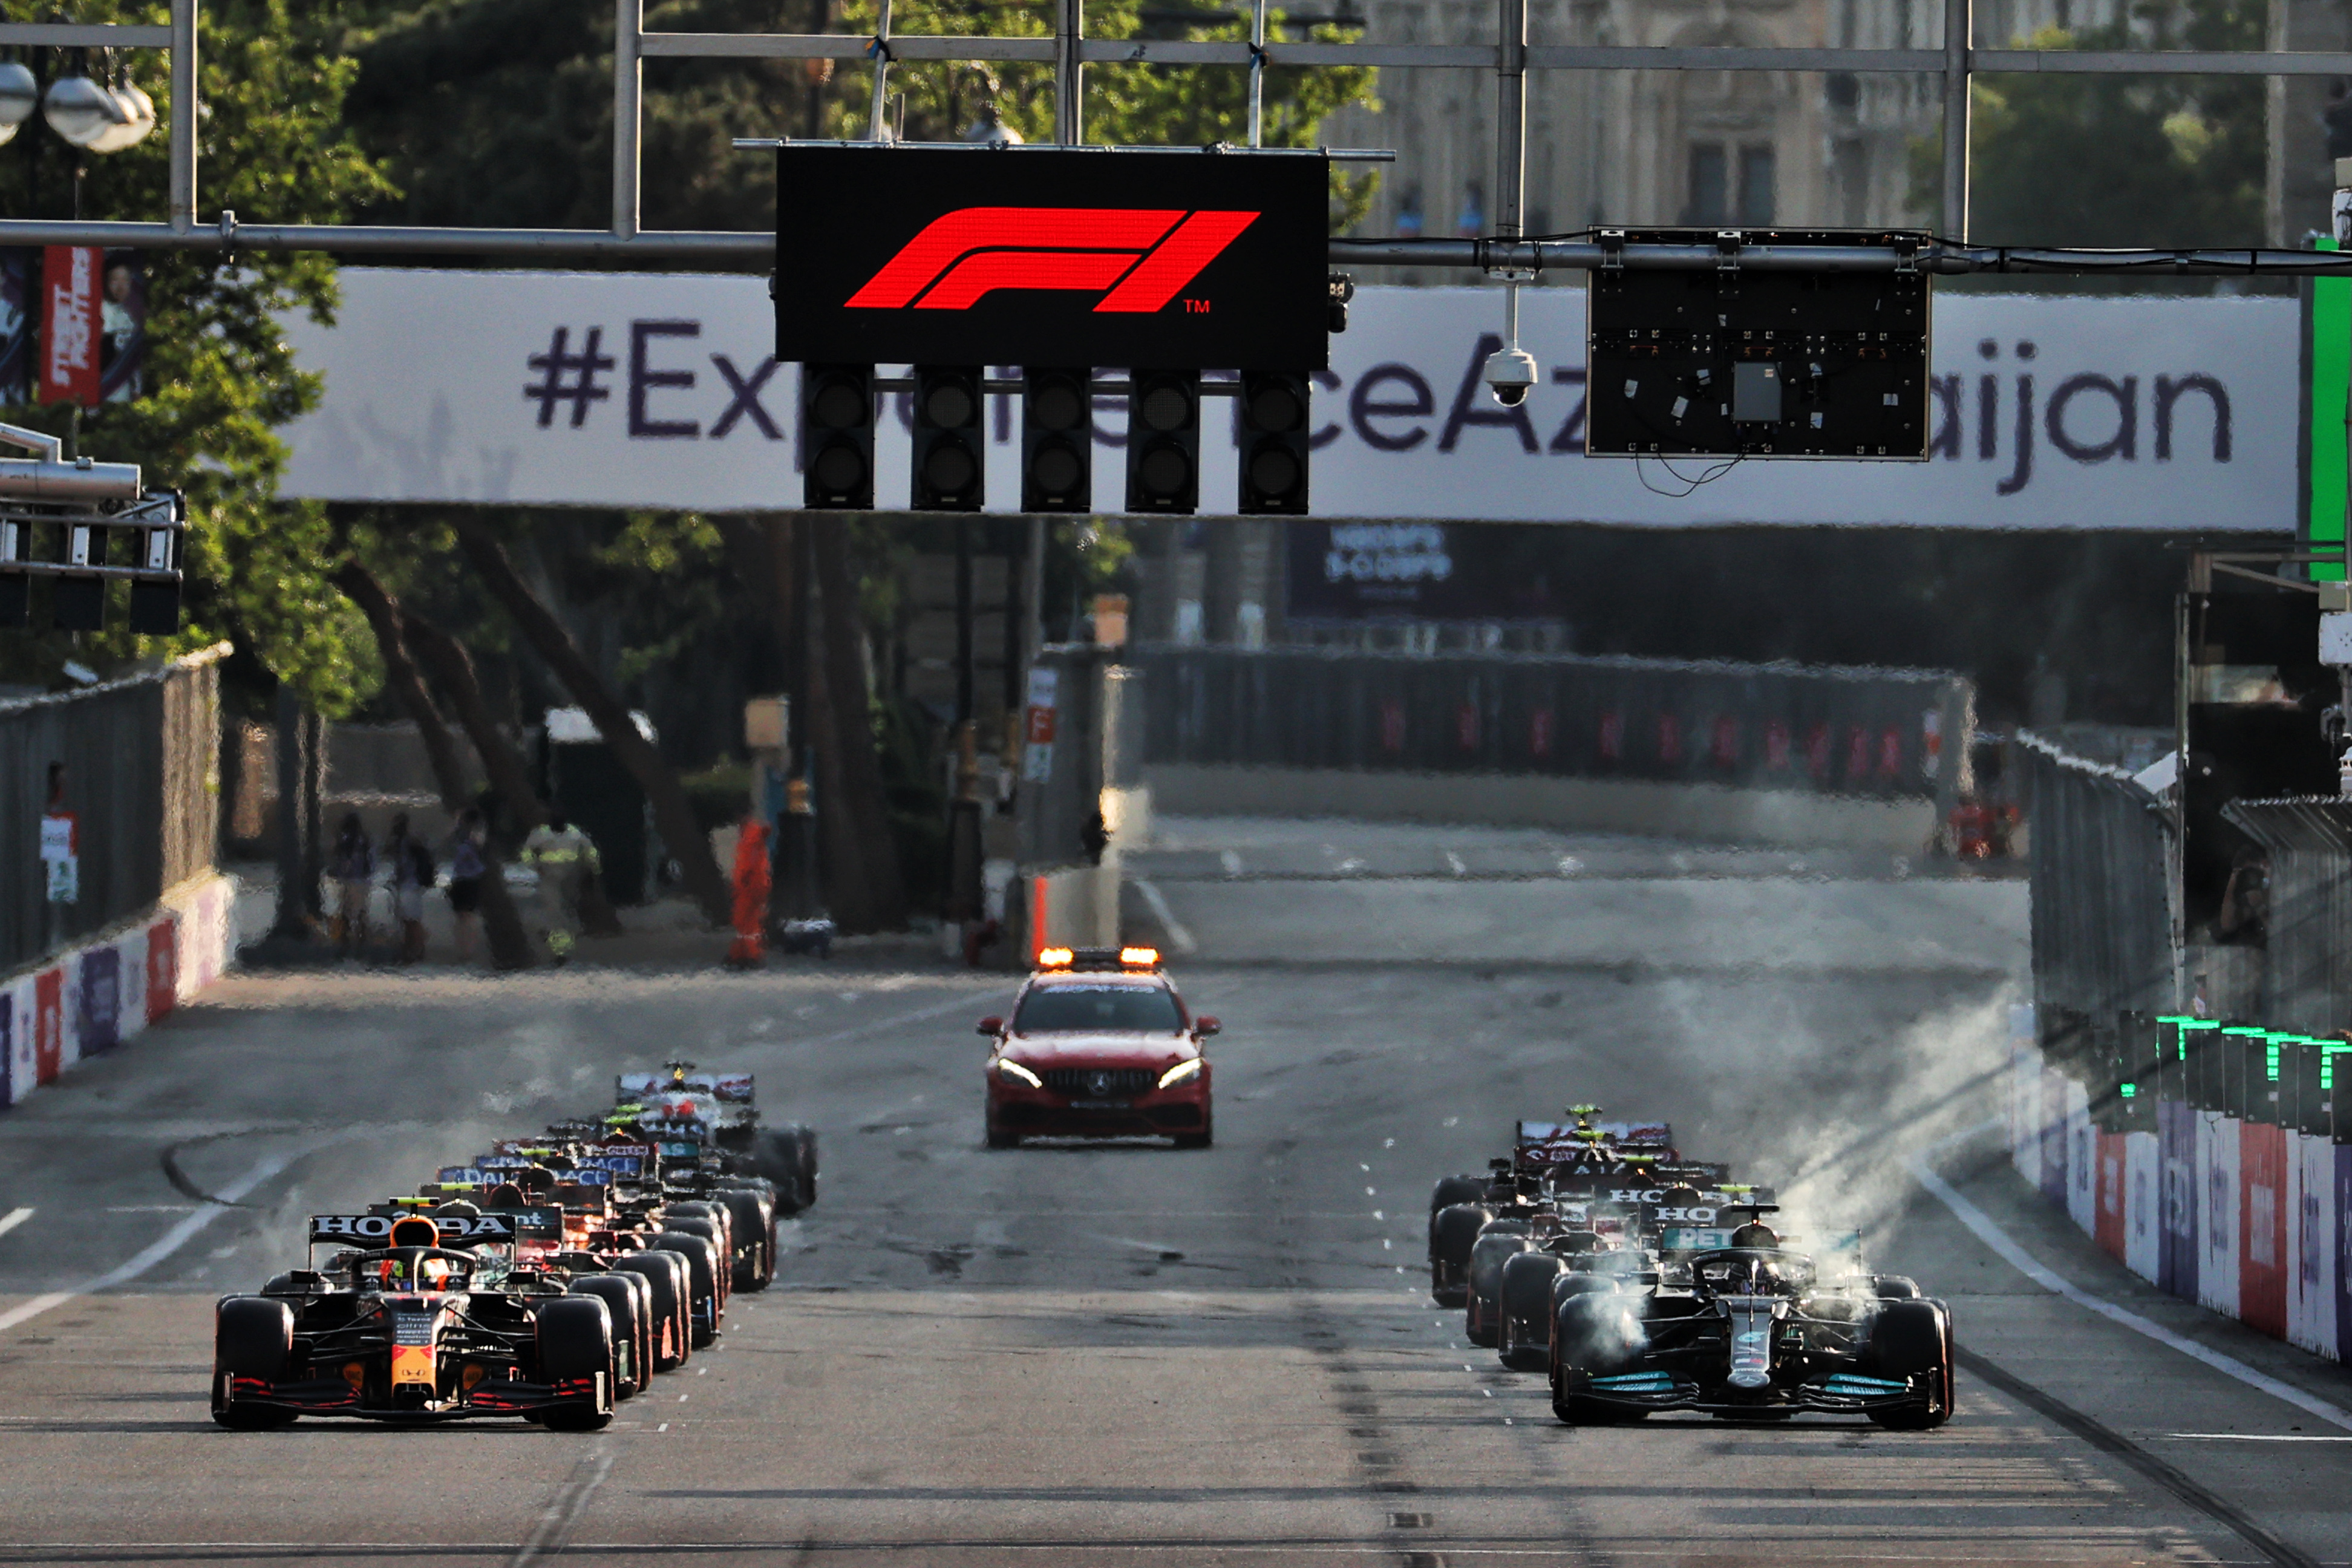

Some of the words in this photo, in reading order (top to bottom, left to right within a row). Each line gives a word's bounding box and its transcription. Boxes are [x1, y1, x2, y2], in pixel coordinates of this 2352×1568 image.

[843, 206, 1262, 313] F1
[1183, 299, 1210, 313] TM
[315, 1216, 512, 1236] HODA
[1616, 1373, 1660, 1381] PETRONAS
[1838, 1375, 1882, 1385] PETRONAS
